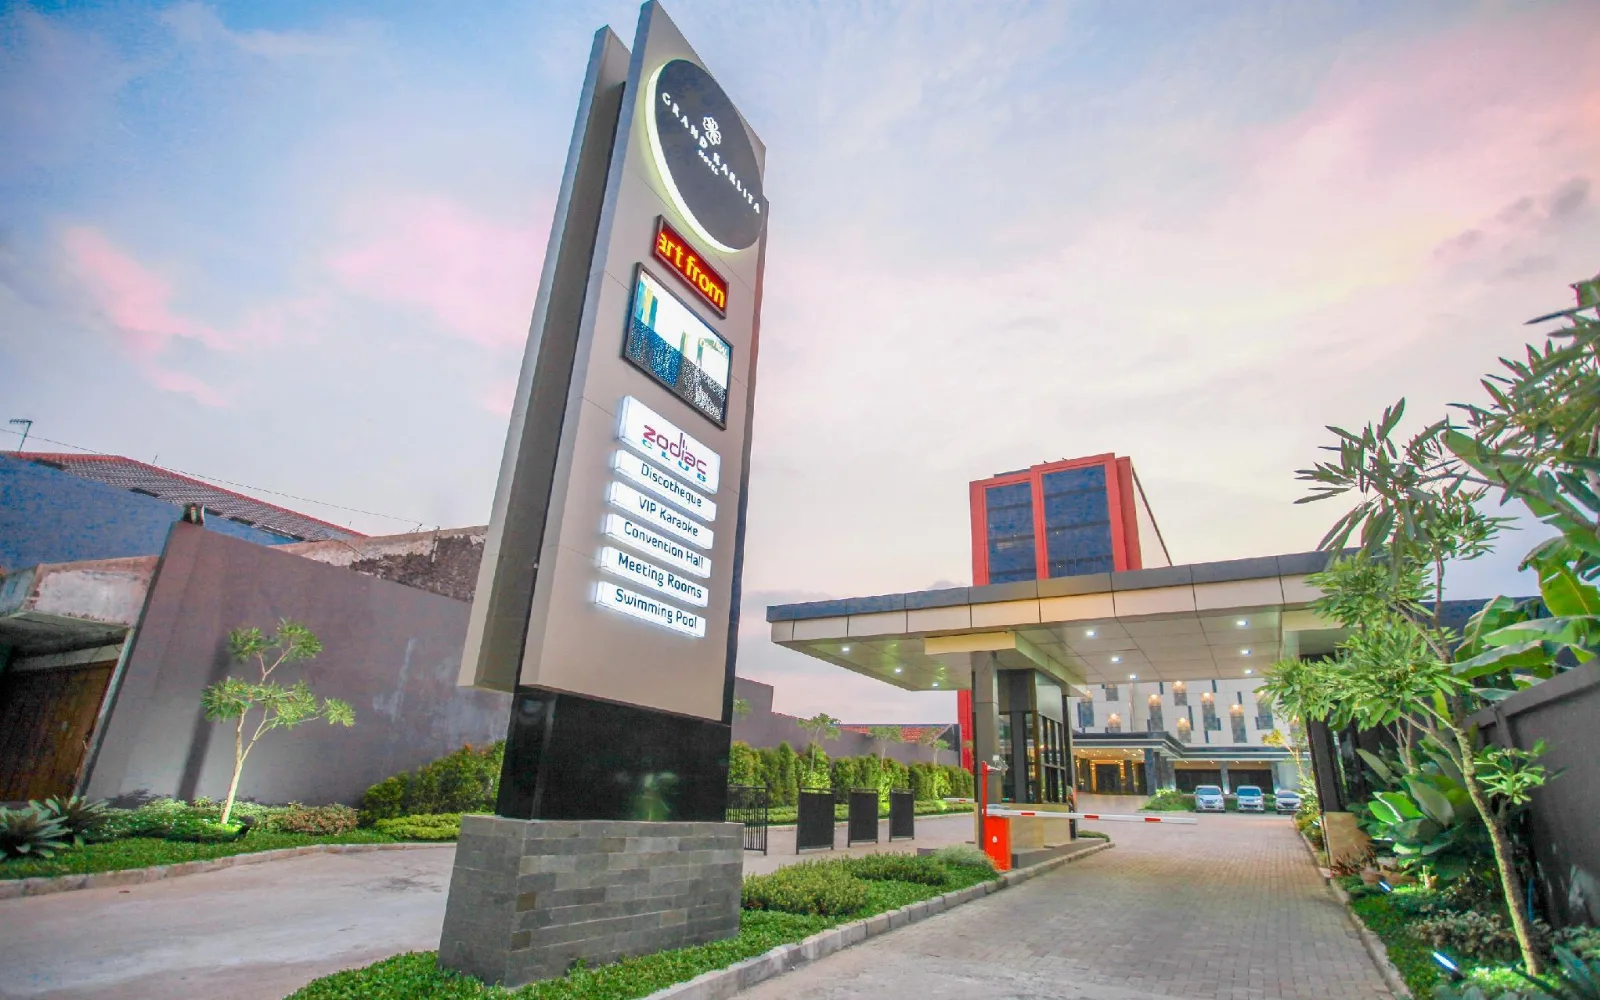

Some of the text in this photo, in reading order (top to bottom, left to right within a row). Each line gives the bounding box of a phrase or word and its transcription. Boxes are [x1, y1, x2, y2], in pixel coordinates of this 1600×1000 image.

[662, 92, 760, 214] GRAND KARLITA
[698, 149, 719, 175] HOTEL
[686, 255, 725, 308] from
[641, 439, 706, 482] CLUB
[643, 424, 707, 475] zodiac
[641, 463, 702, 507] Discotheque
[639, 496, 699, 537] VIP Karaoke
[624, 521, 704, 569] Convention Hall
[618, 552, 702, 599] Meeting Rooms
[615, 588, 697, 629] Swimming Pool
